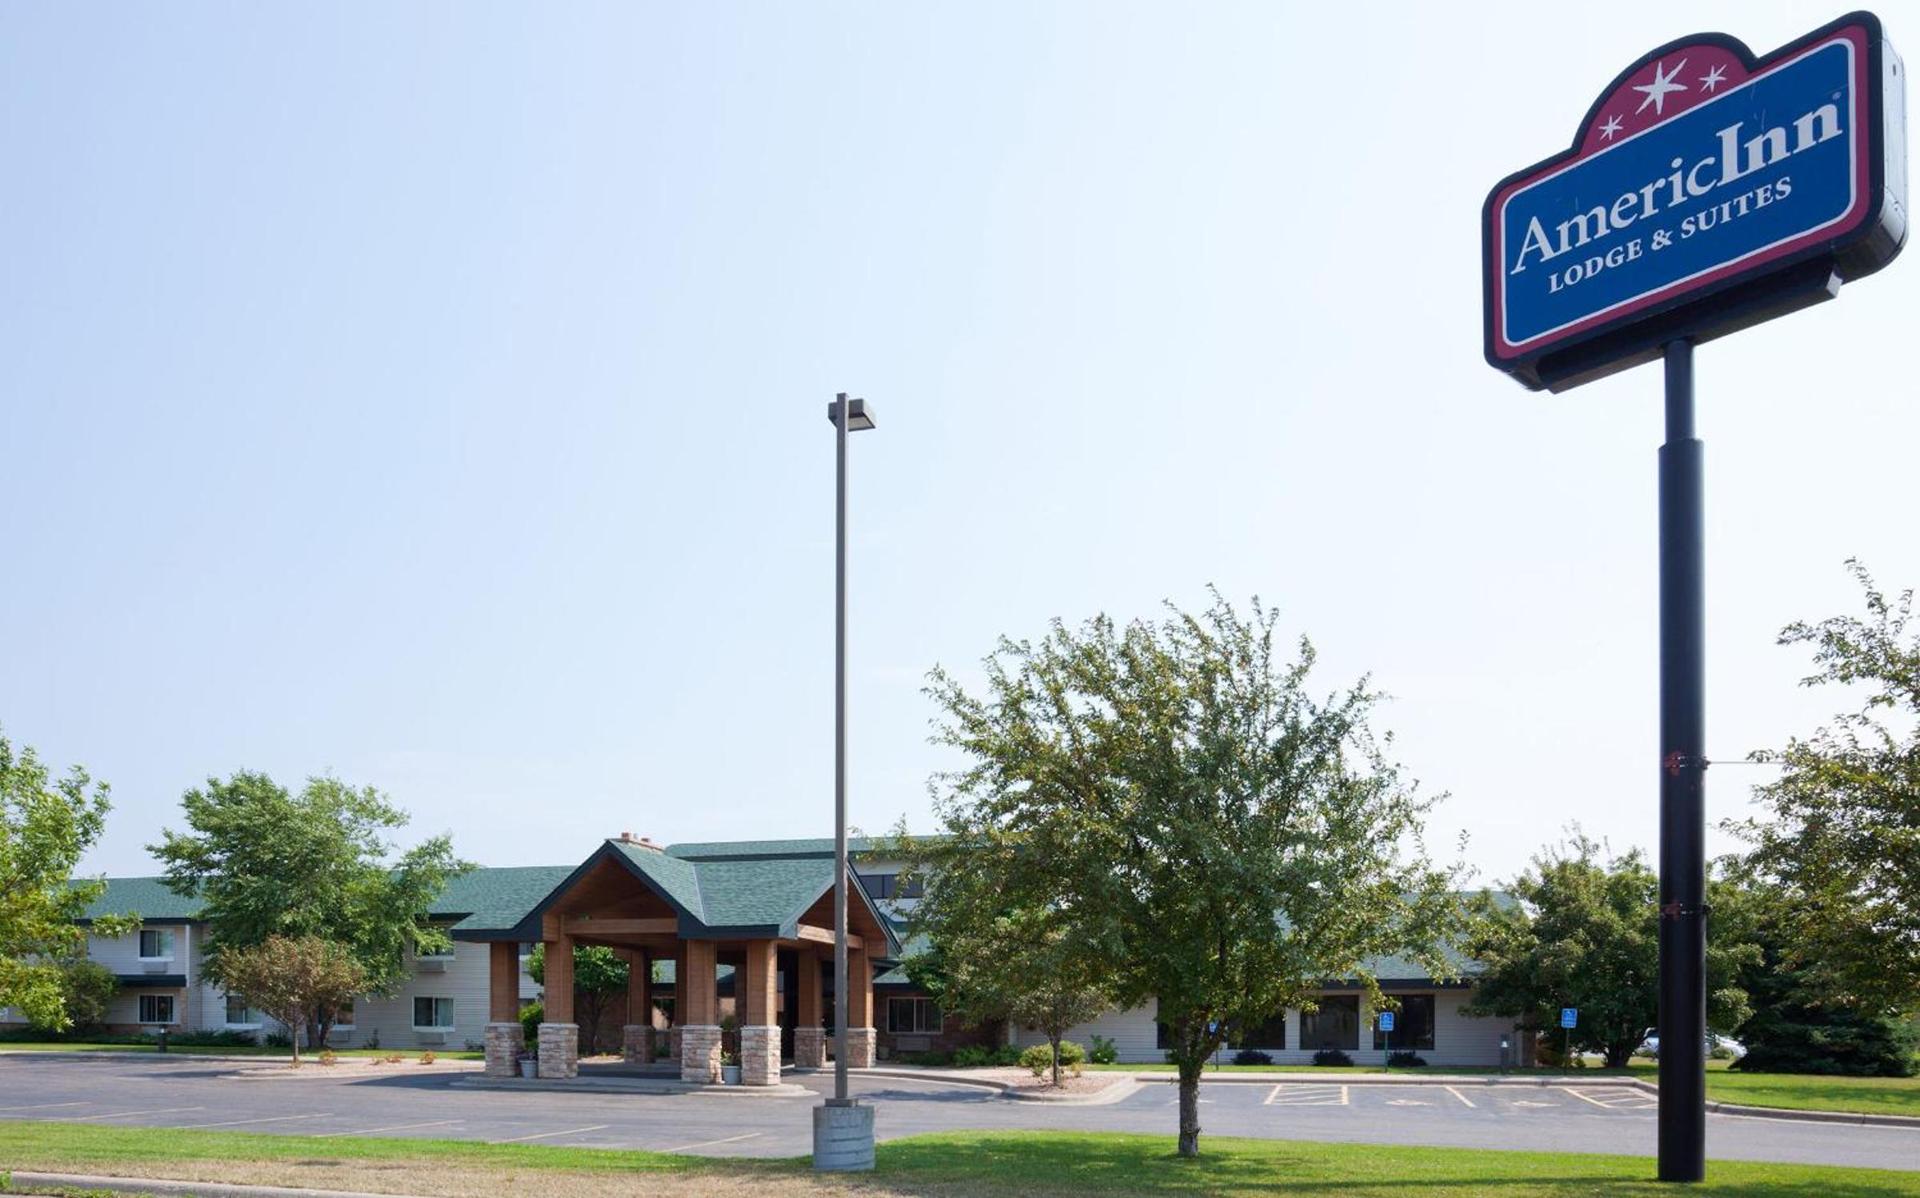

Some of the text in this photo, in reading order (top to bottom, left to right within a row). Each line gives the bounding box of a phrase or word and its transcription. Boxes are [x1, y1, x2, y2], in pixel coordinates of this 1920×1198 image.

[1511, 103, 1842, 274] AmericInn
[1548, 177, 1792, 293] LODGE & SUITES
